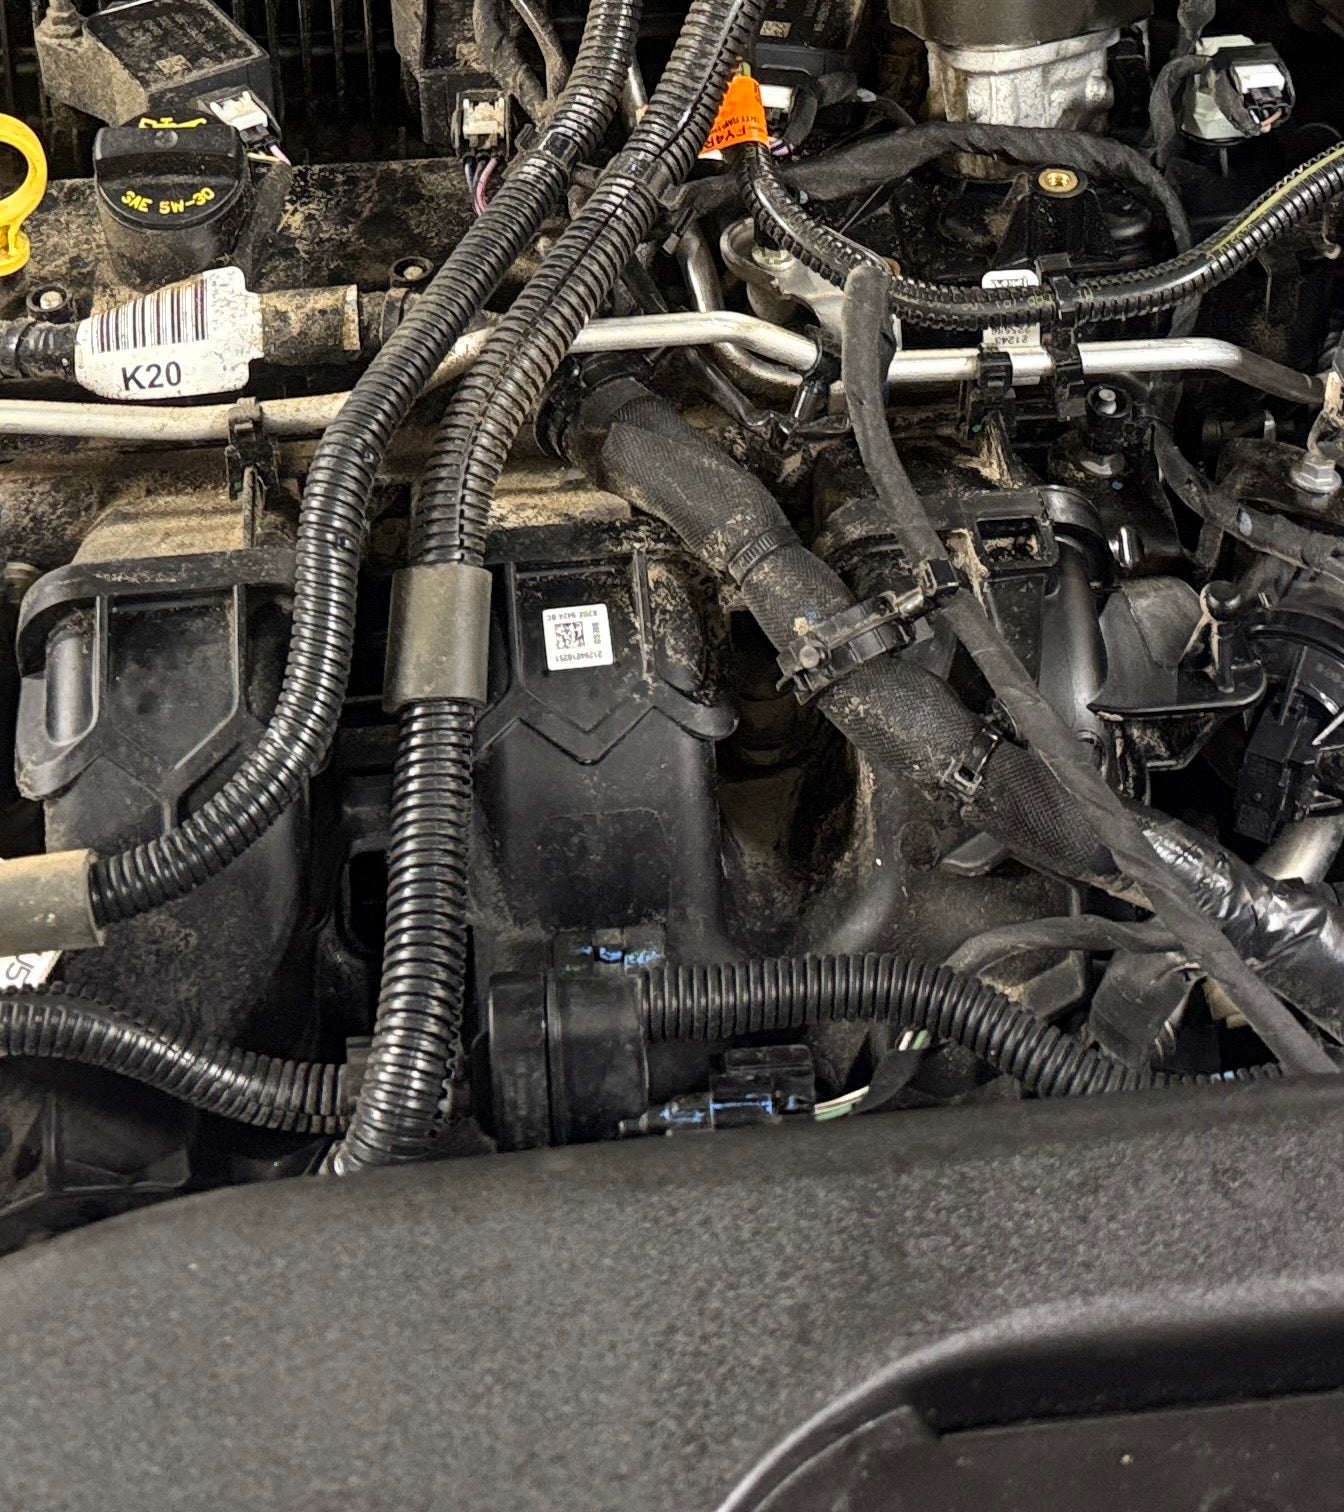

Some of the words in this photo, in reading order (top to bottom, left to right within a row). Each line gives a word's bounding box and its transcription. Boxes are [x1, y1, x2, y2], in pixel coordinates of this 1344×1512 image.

[121, 190, 153, 213] SAE
[158, 187, 216, 215] 5W-30
[121, 361, 182, 391] K20
